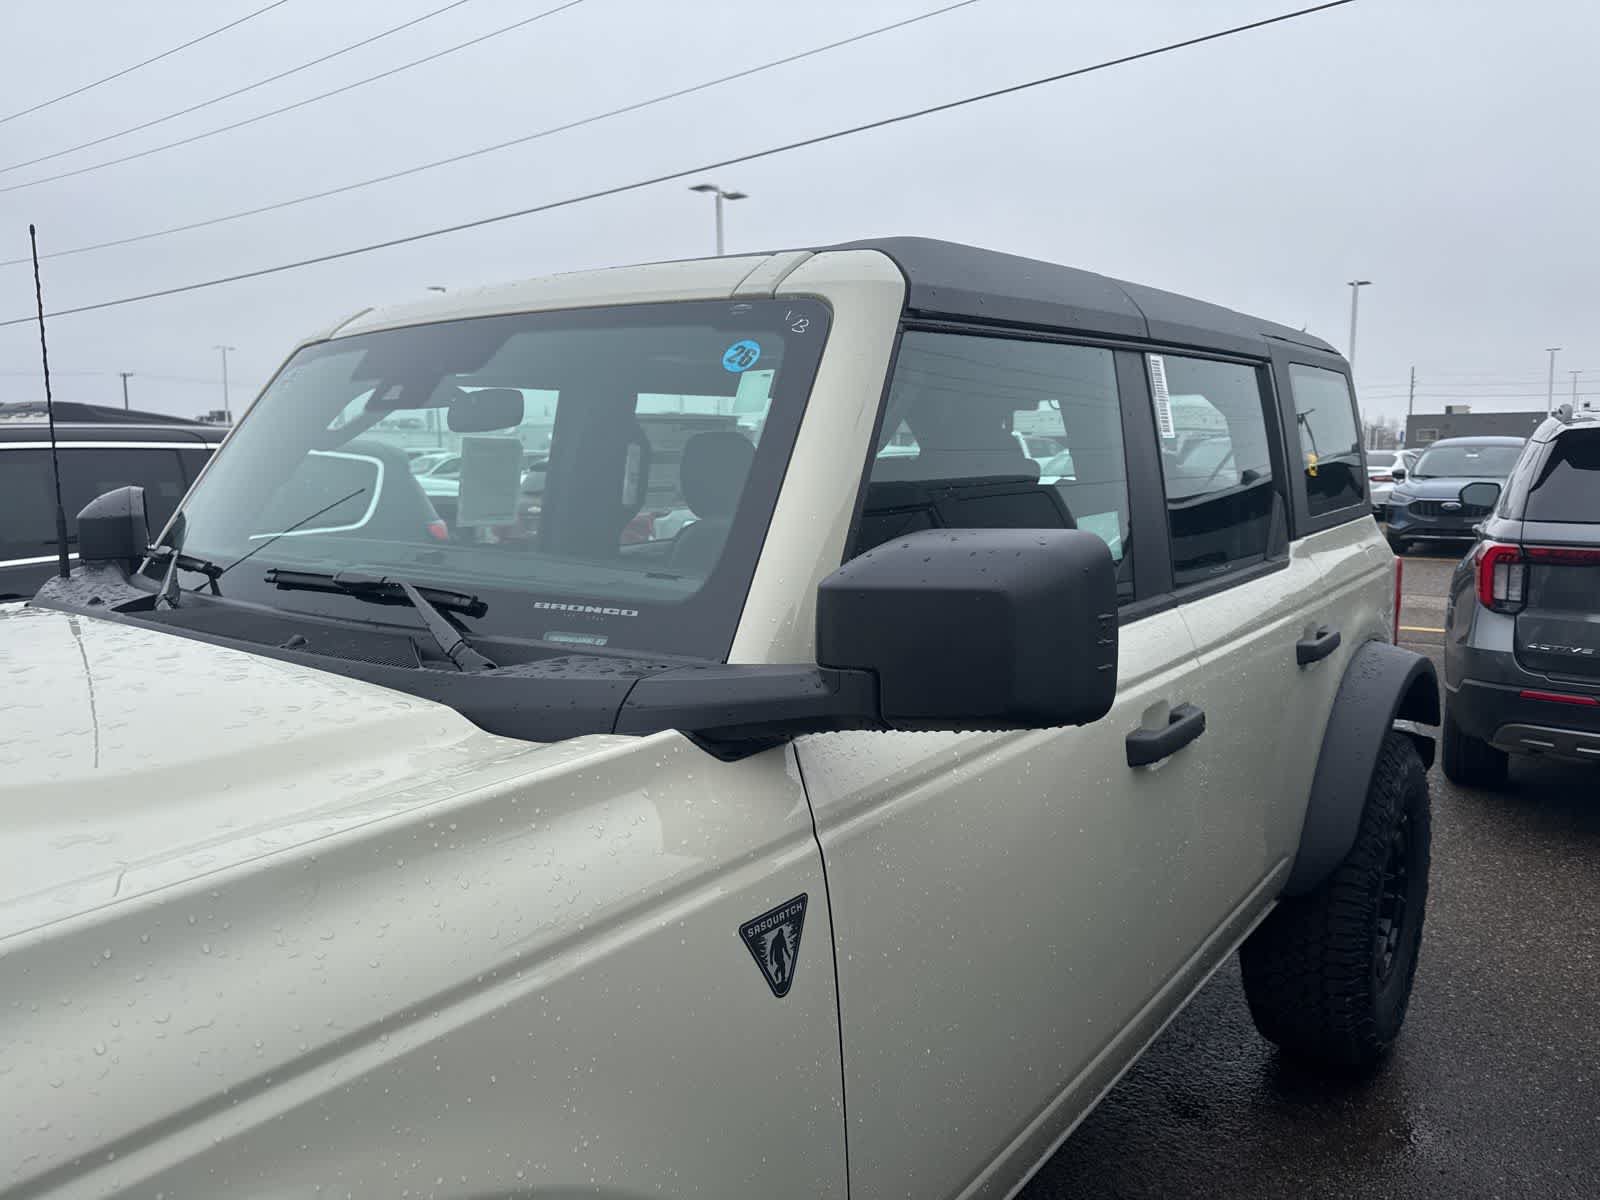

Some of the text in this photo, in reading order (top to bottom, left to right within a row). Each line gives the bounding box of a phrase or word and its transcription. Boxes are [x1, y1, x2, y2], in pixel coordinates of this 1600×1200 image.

[726, 344, 758, 368] 26
[533, 601, 639, 617] BRONCO
[747, 902, 803, 938] SASQUATCH
